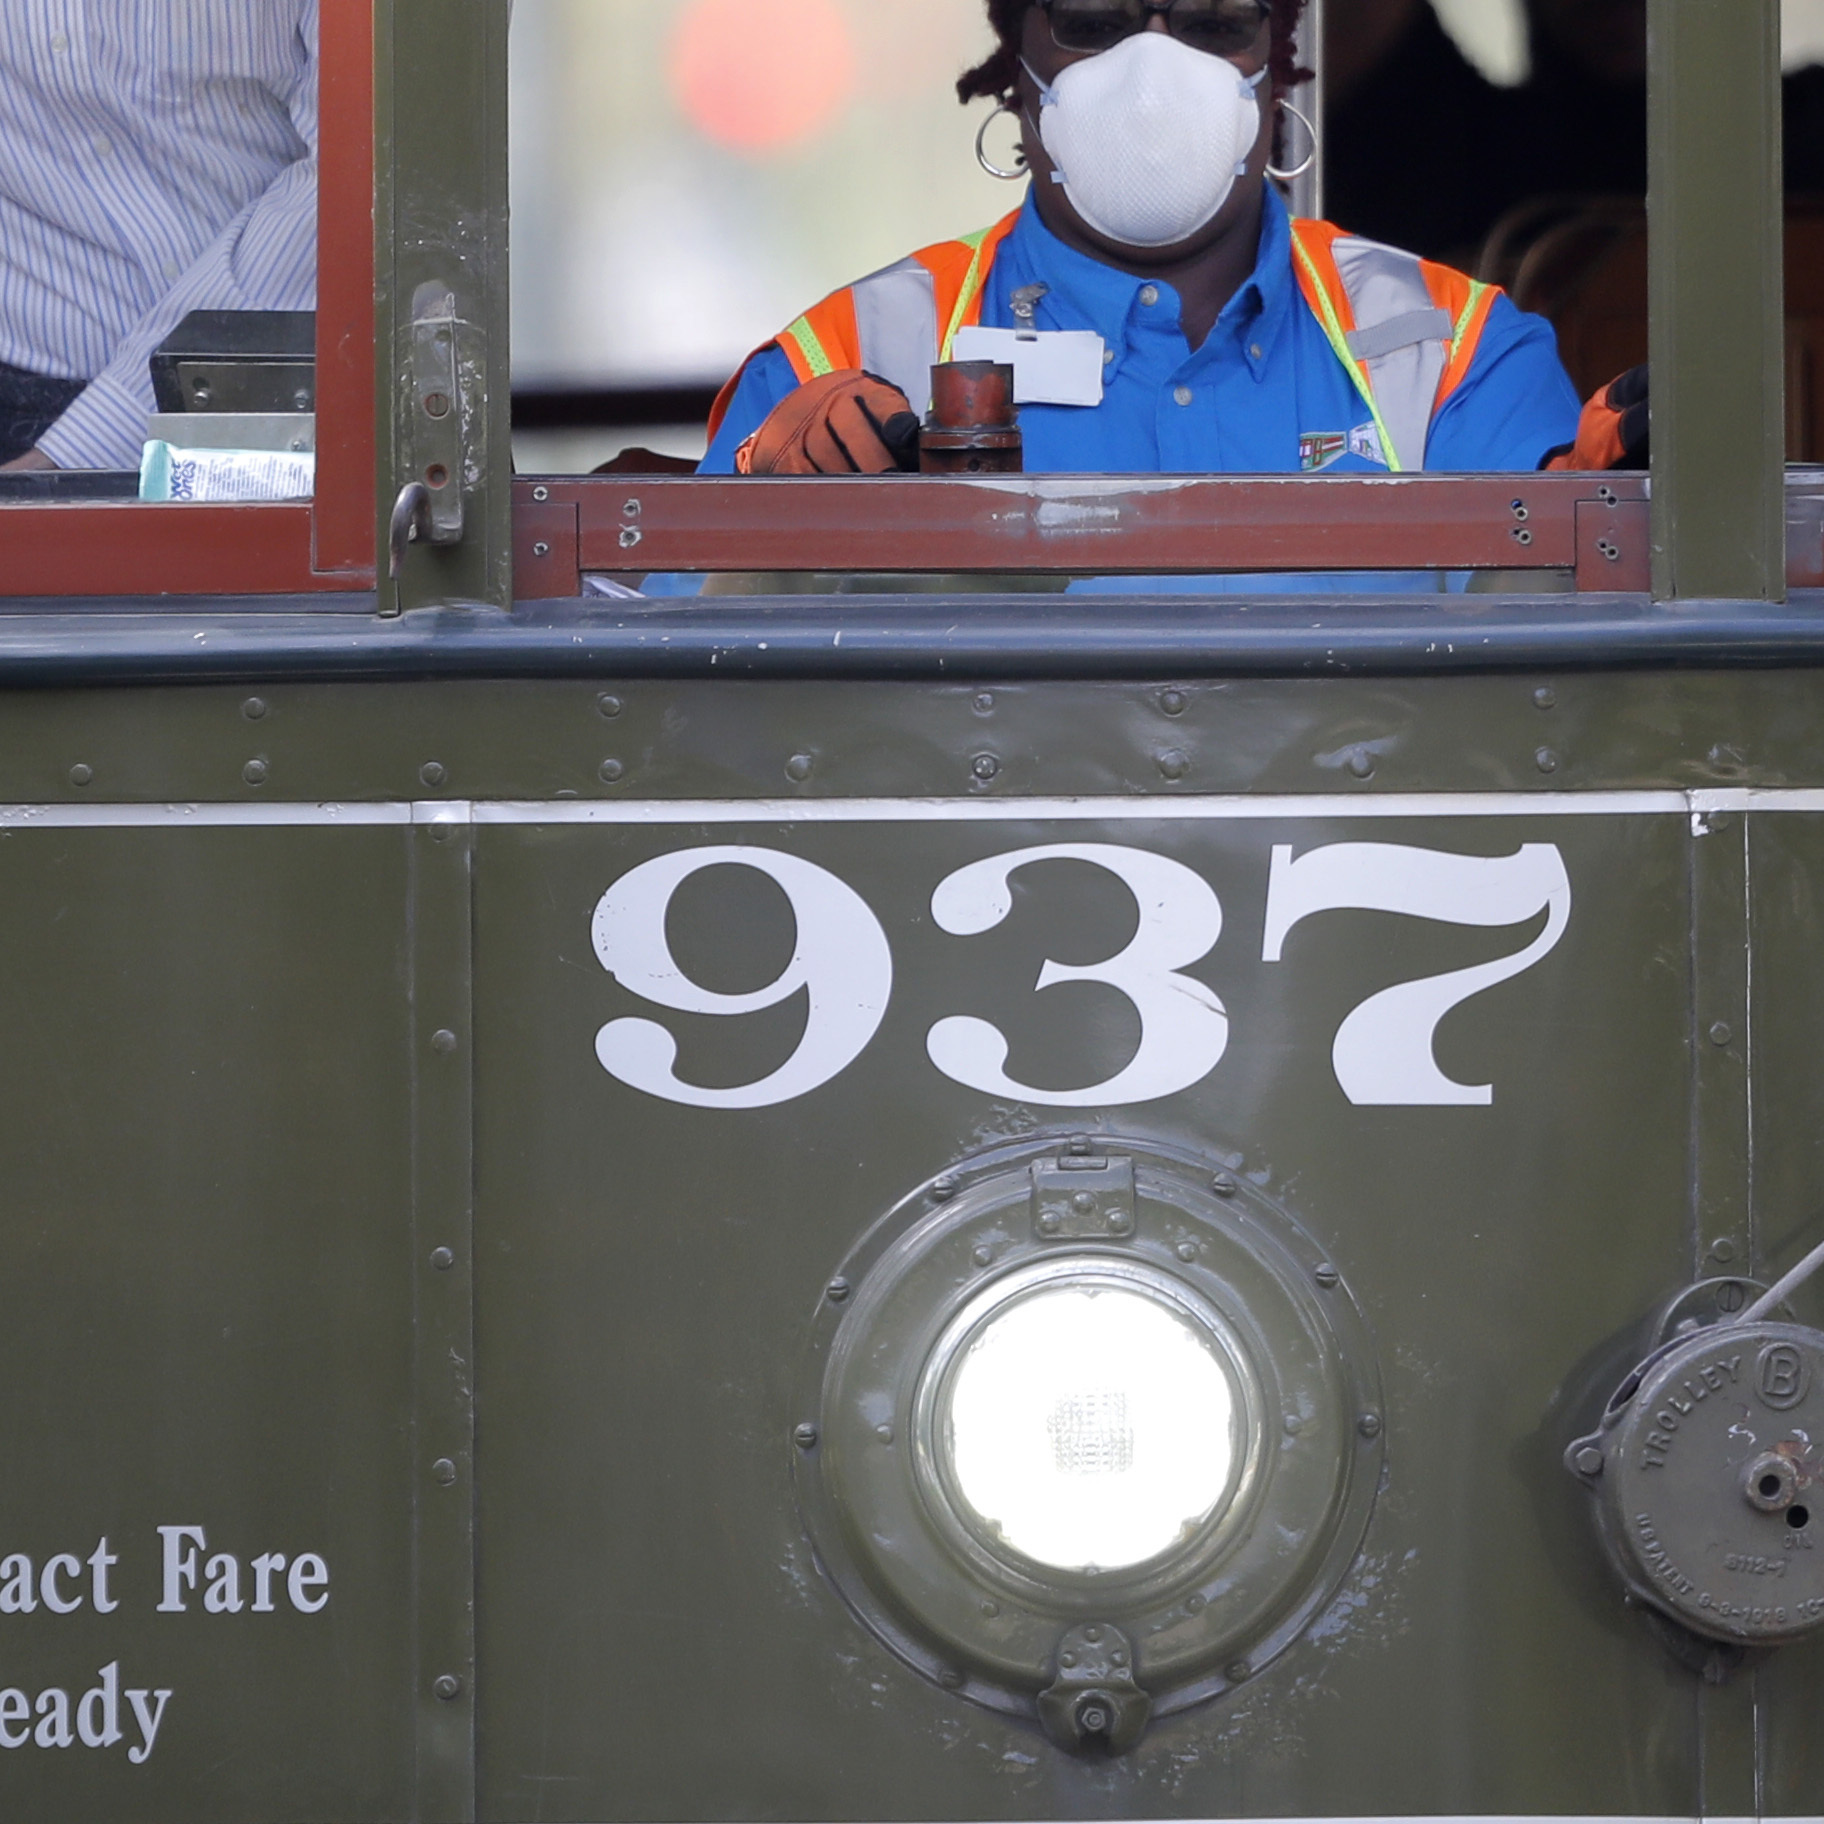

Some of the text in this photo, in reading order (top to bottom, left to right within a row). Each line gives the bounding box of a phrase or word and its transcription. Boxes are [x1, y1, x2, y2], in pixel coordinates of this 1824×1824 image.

[592, 842, 1571, 1108] 937
[1641, 1355, 1742, 1472] TROLLEY
[156, 1525, 330, 1615] Fare
